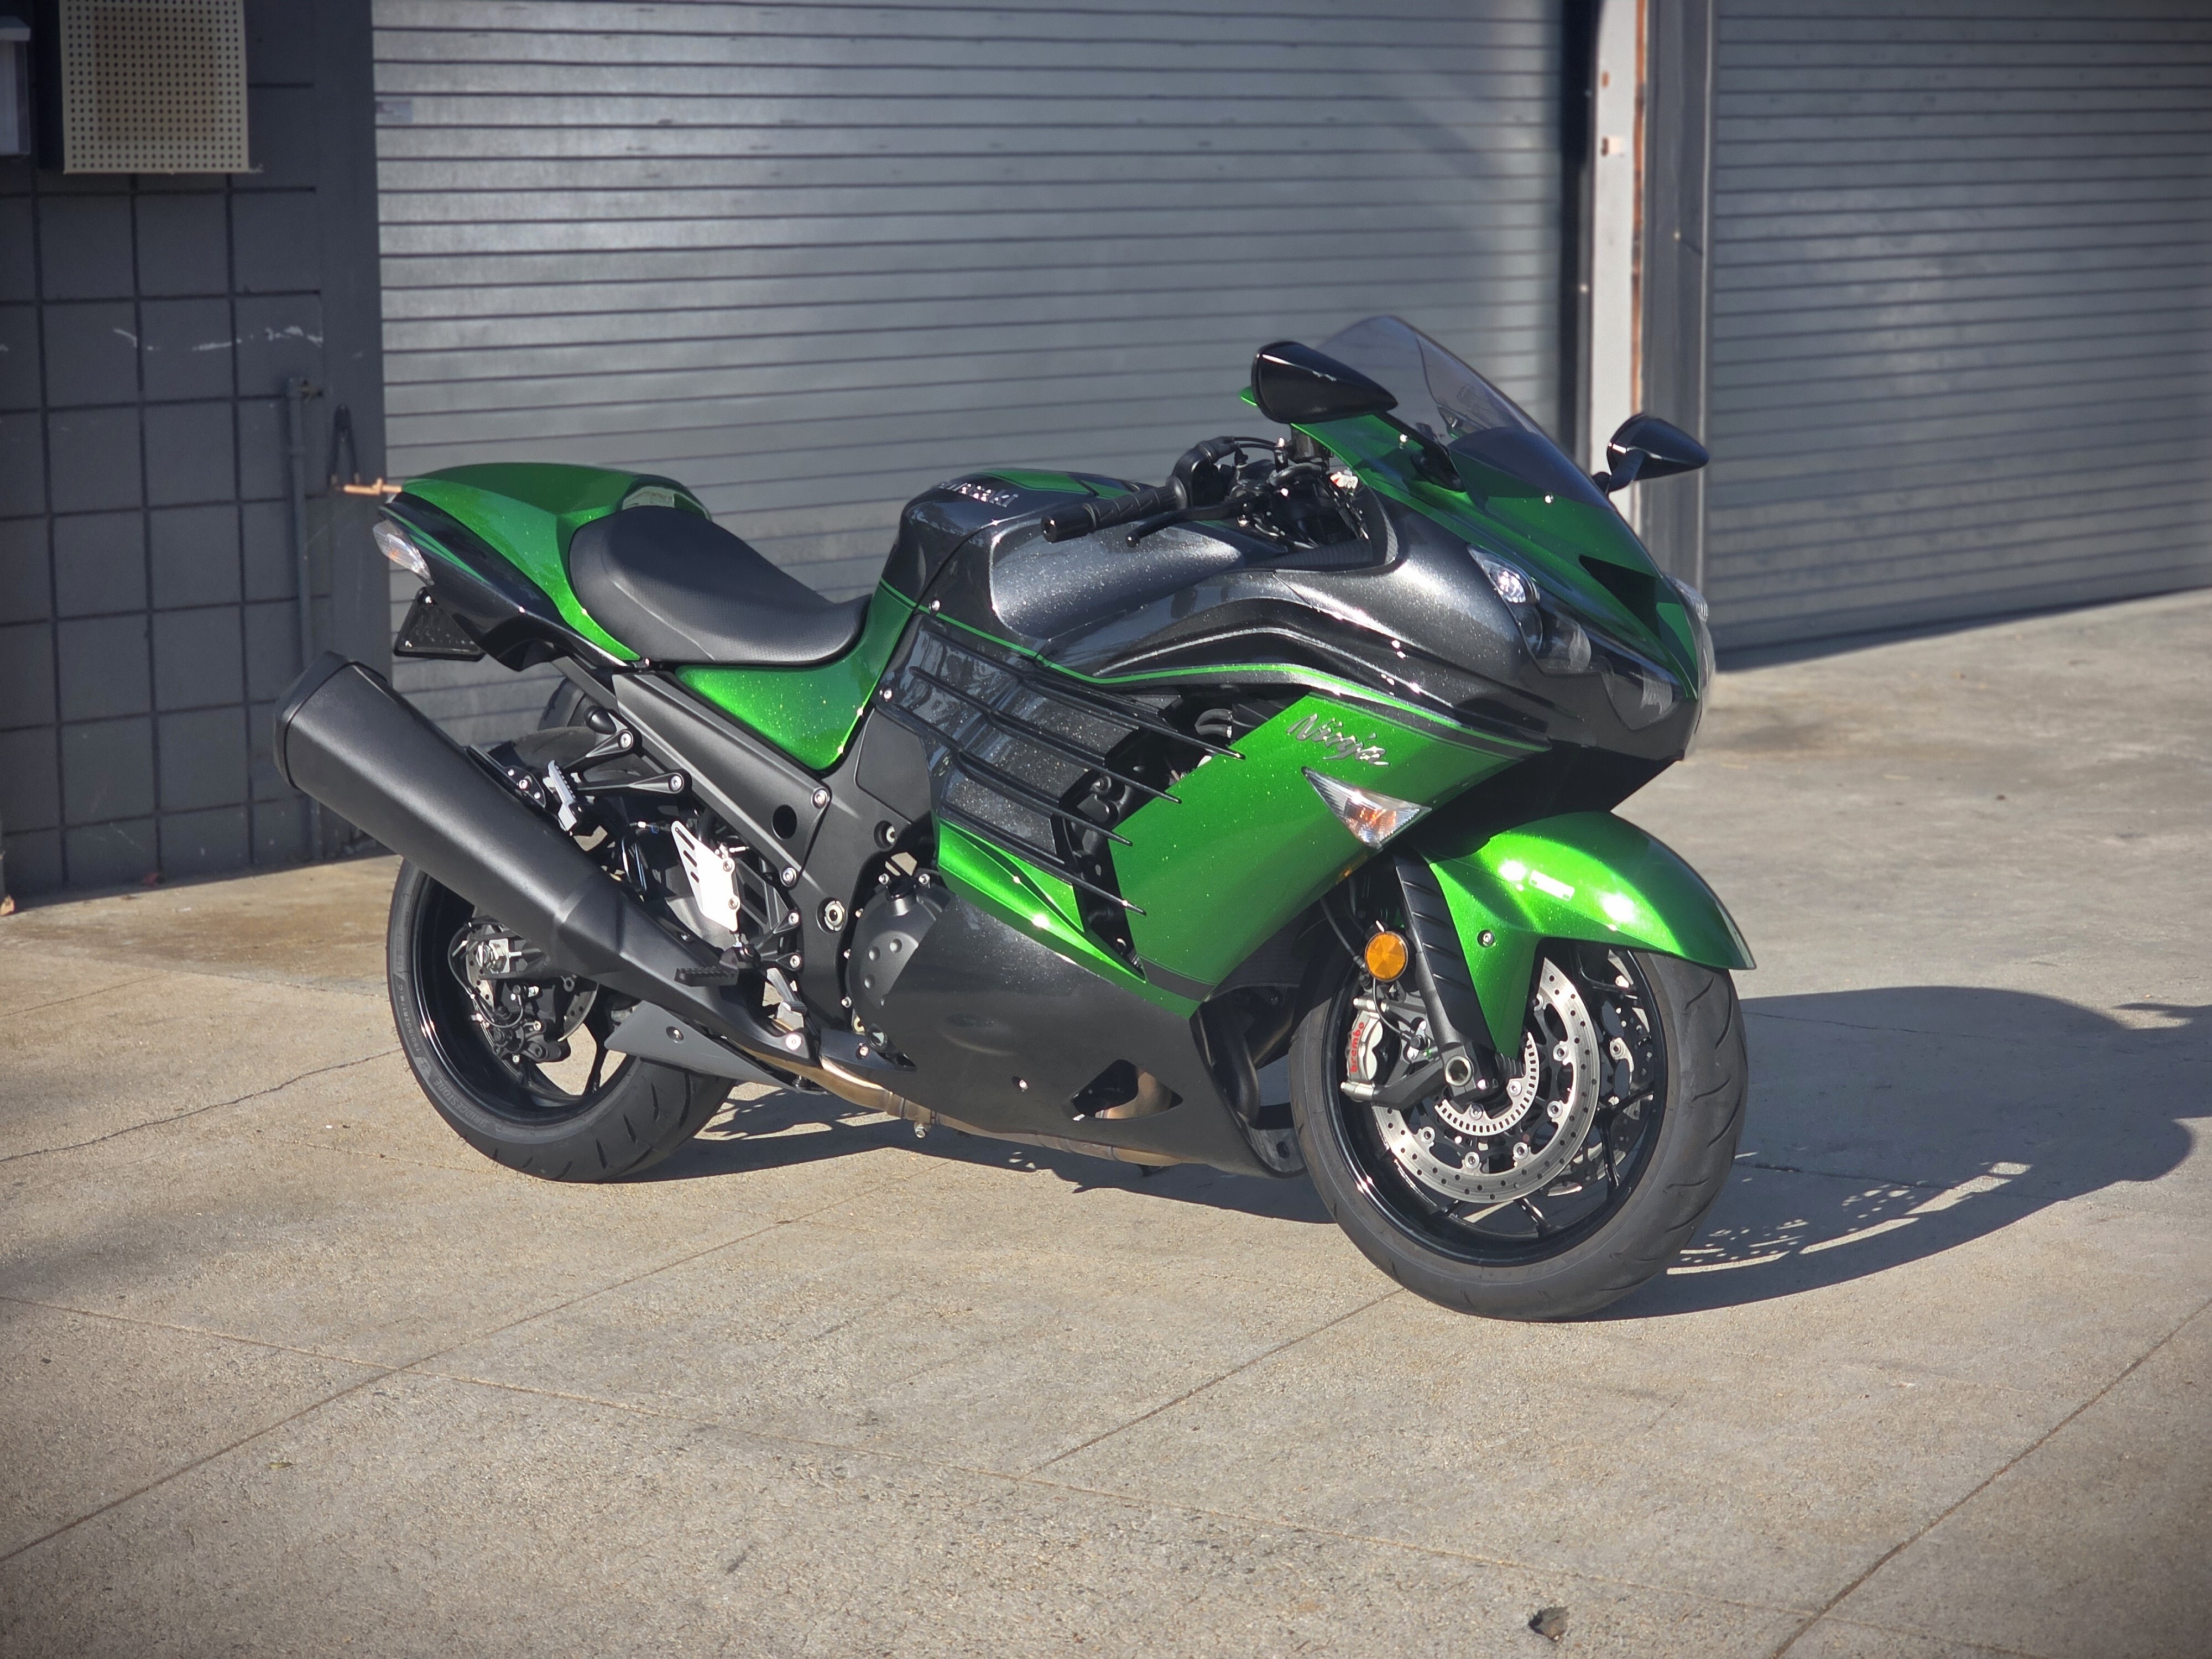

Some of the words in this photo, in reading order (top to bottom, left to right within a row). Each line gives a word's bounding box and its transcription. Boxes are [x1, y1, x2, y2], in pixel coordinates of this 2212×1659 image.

[1287, 713, 1390, 765] Ninja
[1350, 1021, 1364, 1072] brembo
[434, 1078, 490, 1128] BRIDGESTONE
